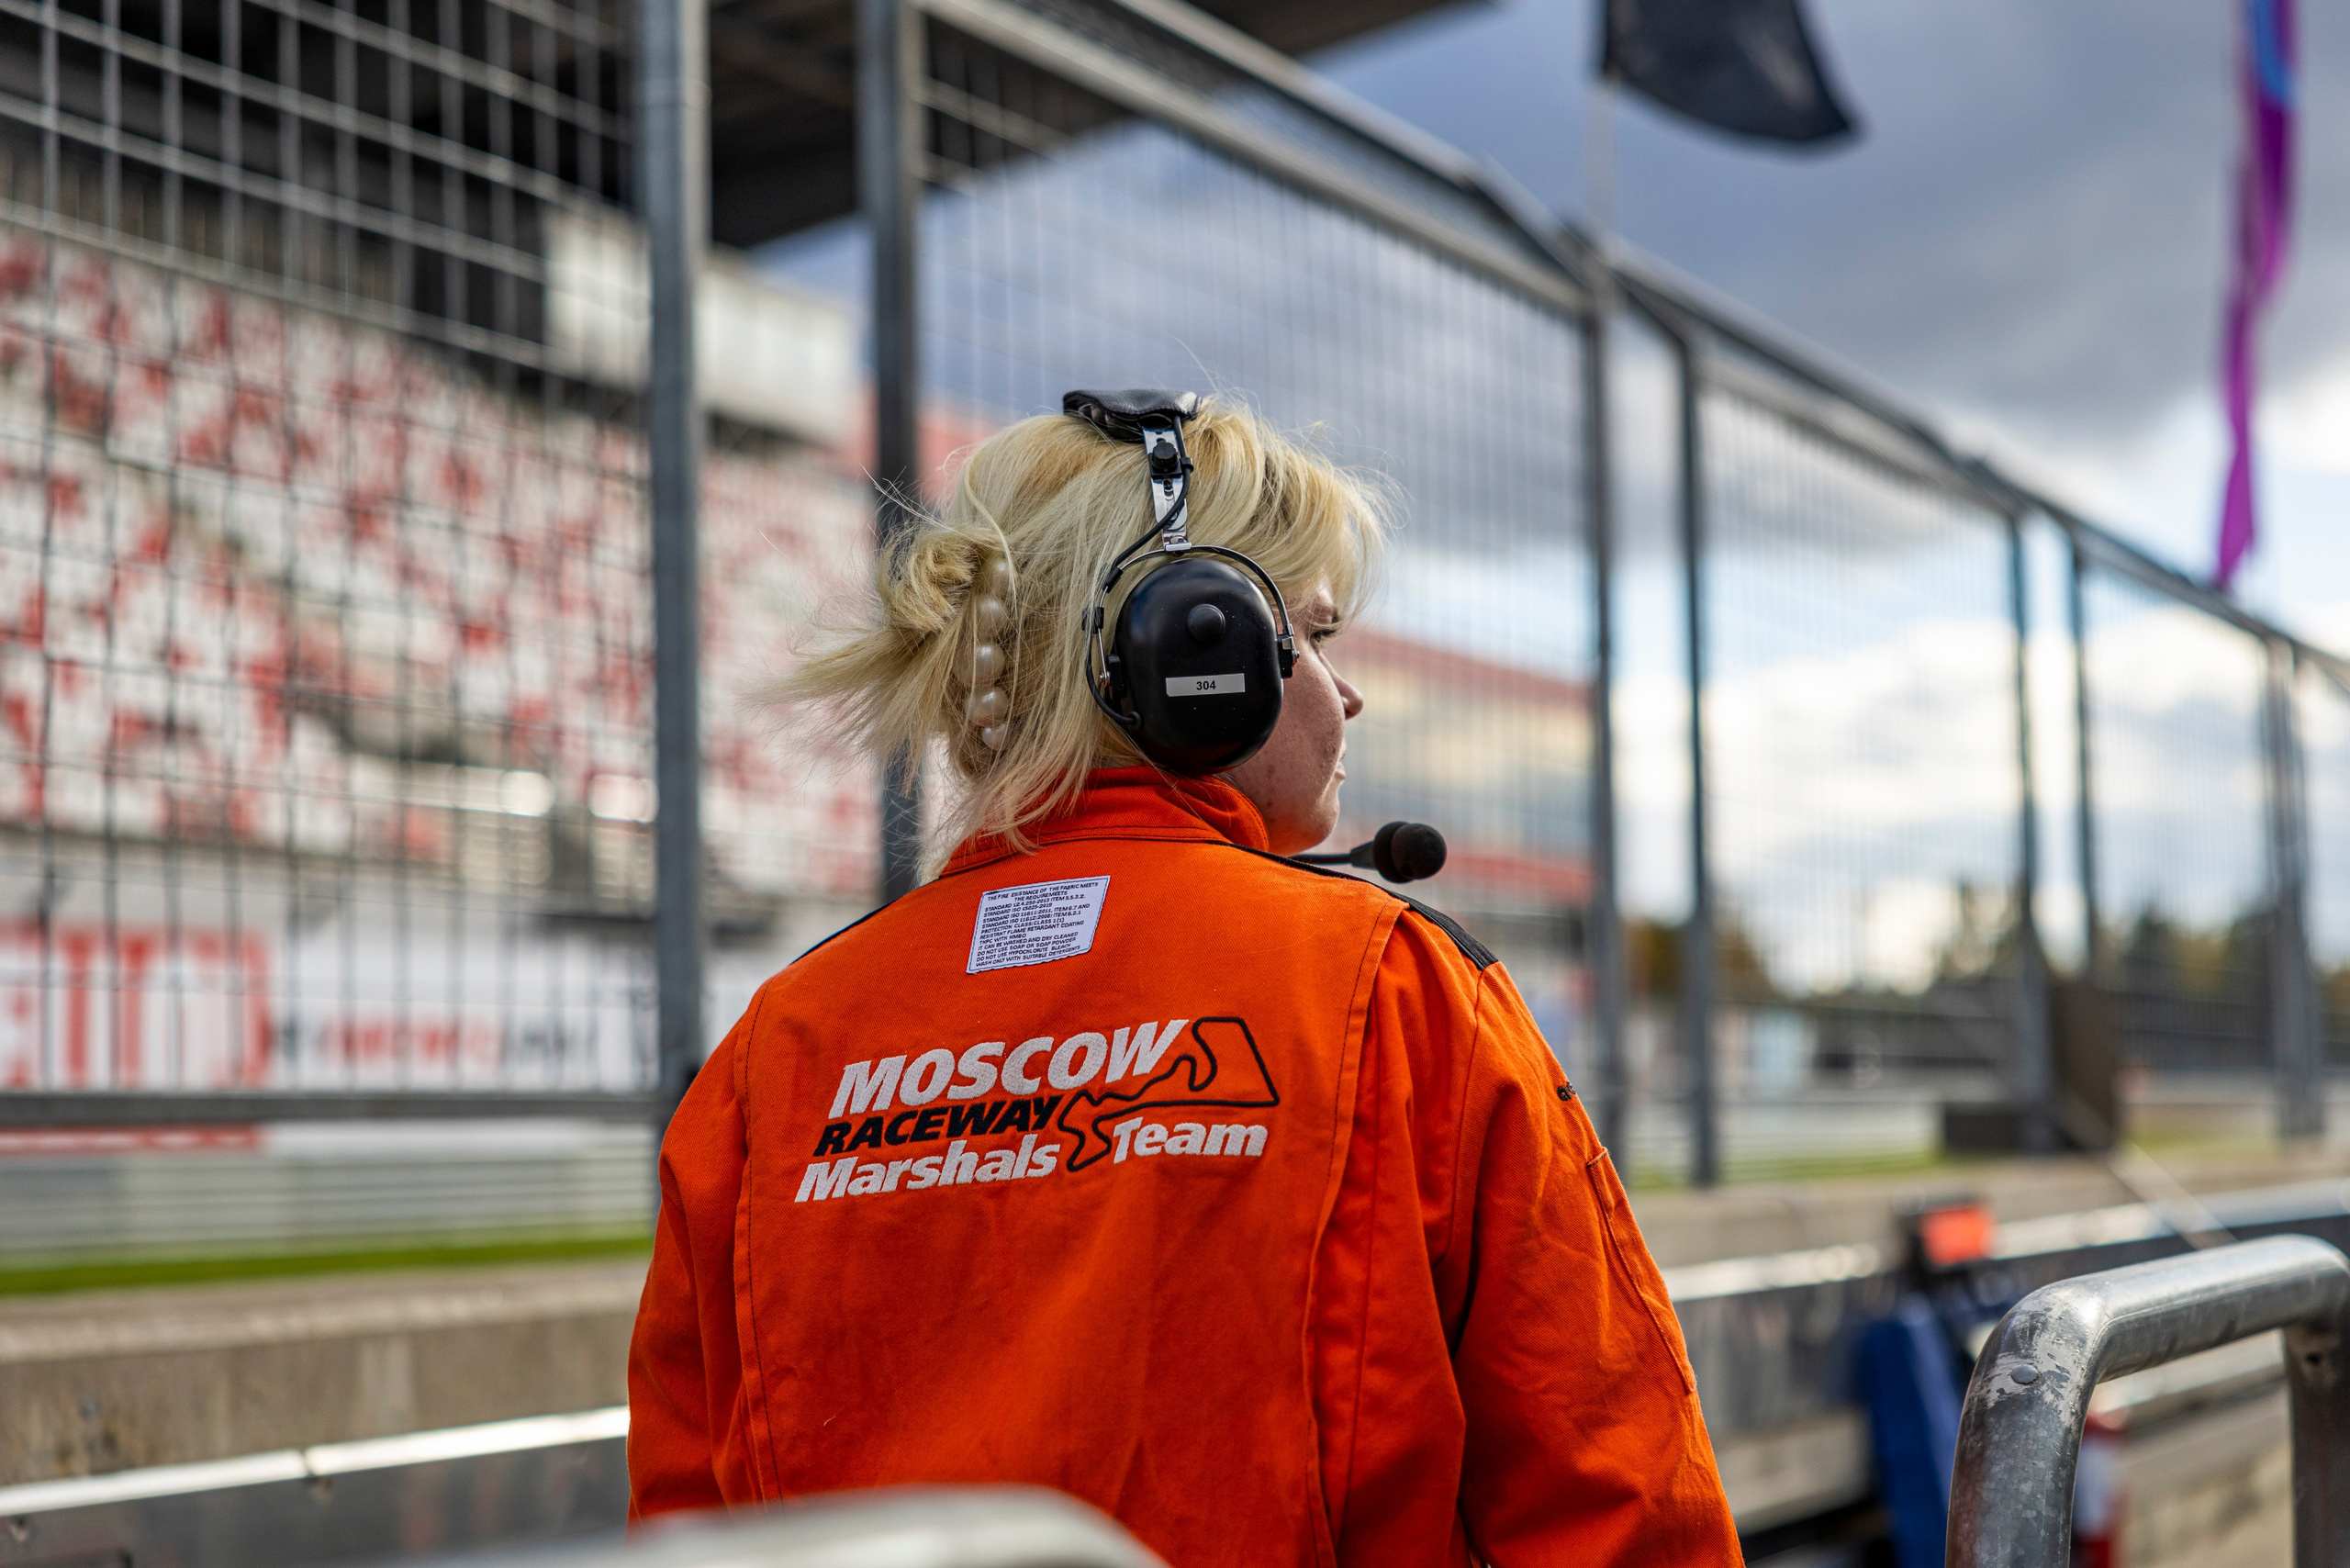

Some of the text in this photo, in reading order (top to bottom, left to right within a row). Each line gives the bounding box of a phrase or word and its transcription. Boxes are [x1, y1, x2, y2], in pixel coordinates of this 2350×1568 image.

[1196, 681, 1216, 690] 304
[985, 903, 1012, 912] STANDARD
[984, 909, 1011, 917] STANDARD
[983, 914, 1010, 924] STANDARD
[982, 920, 1008, 929] STANDARD
[979, 931, 1006, 939] RESISTANT
[1027, 924, 1059, 932] RETARDANT
[981, 925, 1013, 934] PROTECTION
[1052, 937, 1076, 946] POWDER
[1048, 946, 1080, 956] DETERGENTS
[828, 1019, 1190, 1120] MOSCOW
[812, 1094, 1066, 1158] RACEWAY
[793, 1117, 1269, 1204] Marshals Team
